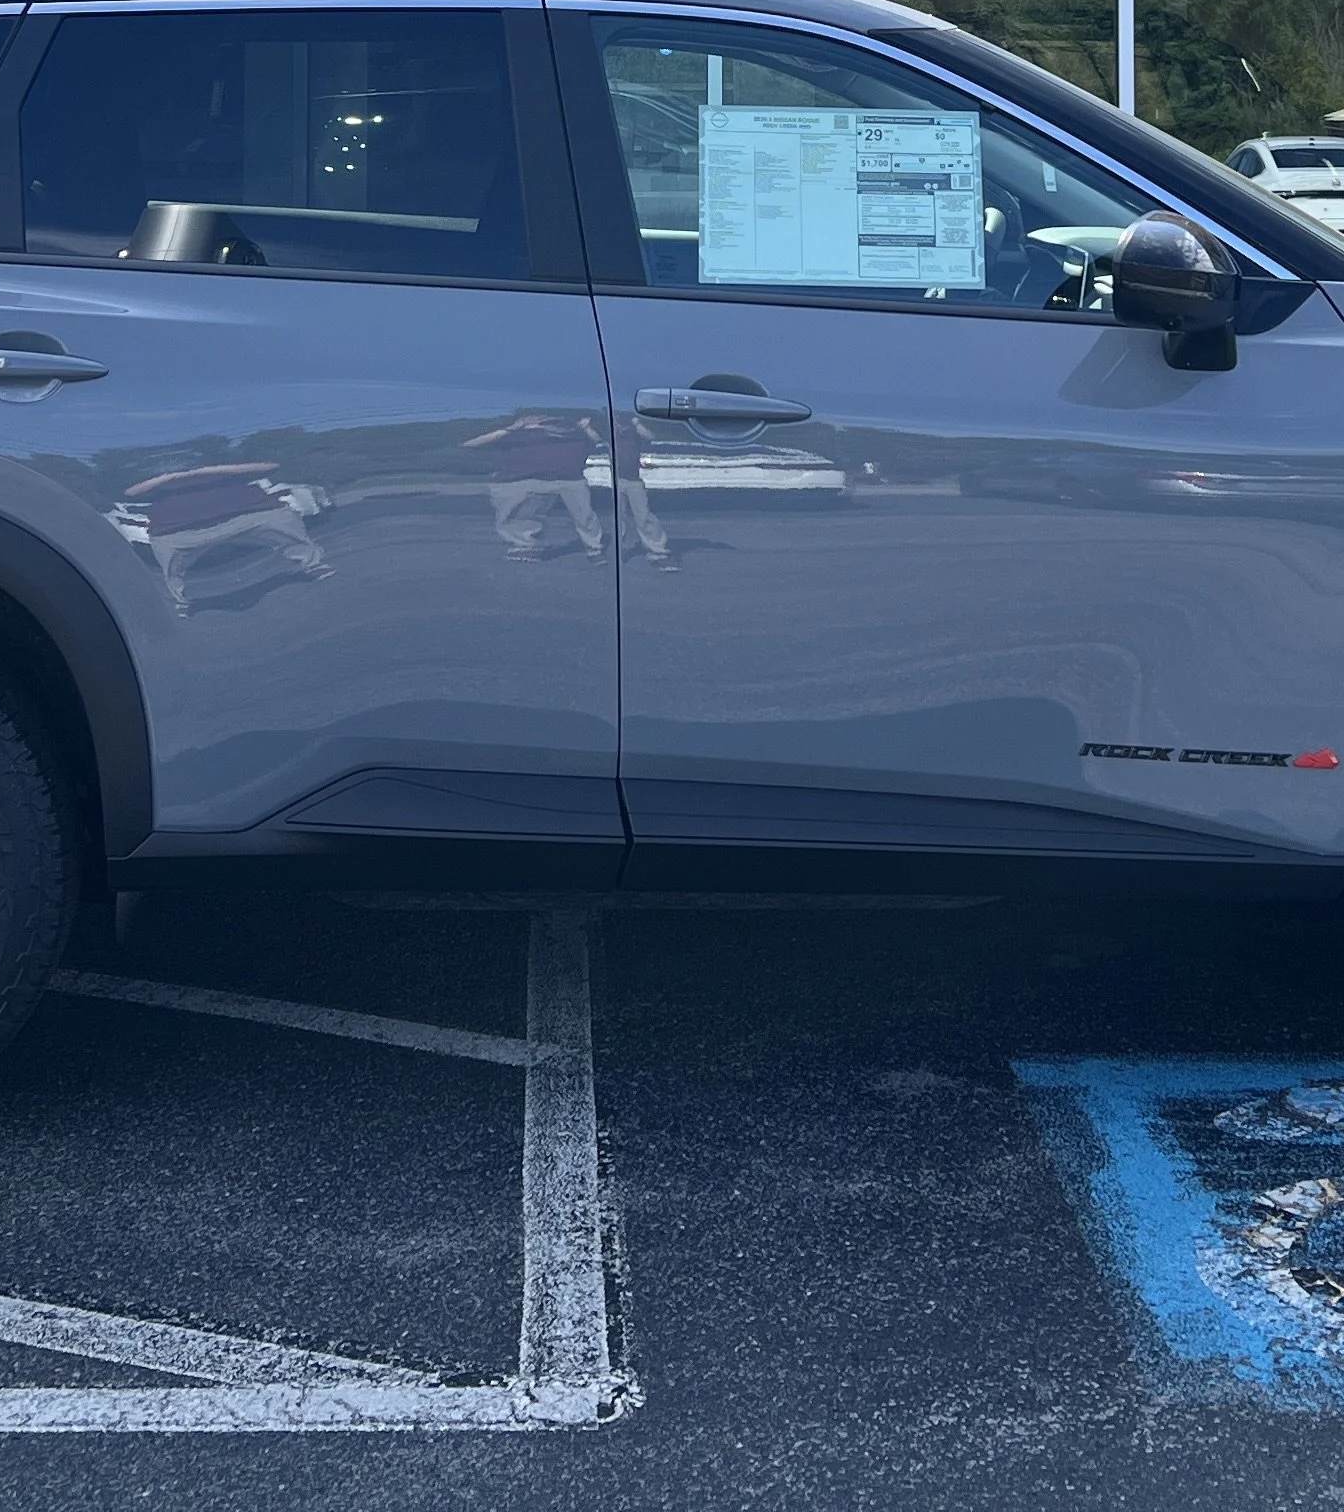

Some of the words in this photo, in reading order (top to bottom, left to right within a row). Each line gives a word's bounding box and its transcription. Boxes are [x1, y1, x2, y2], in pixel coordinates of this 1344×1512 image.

[864, 128, 883, 142] 29
[1078, 742, 1175, 762] ROCK
[1178, 748, 1293, 768] CREEK
